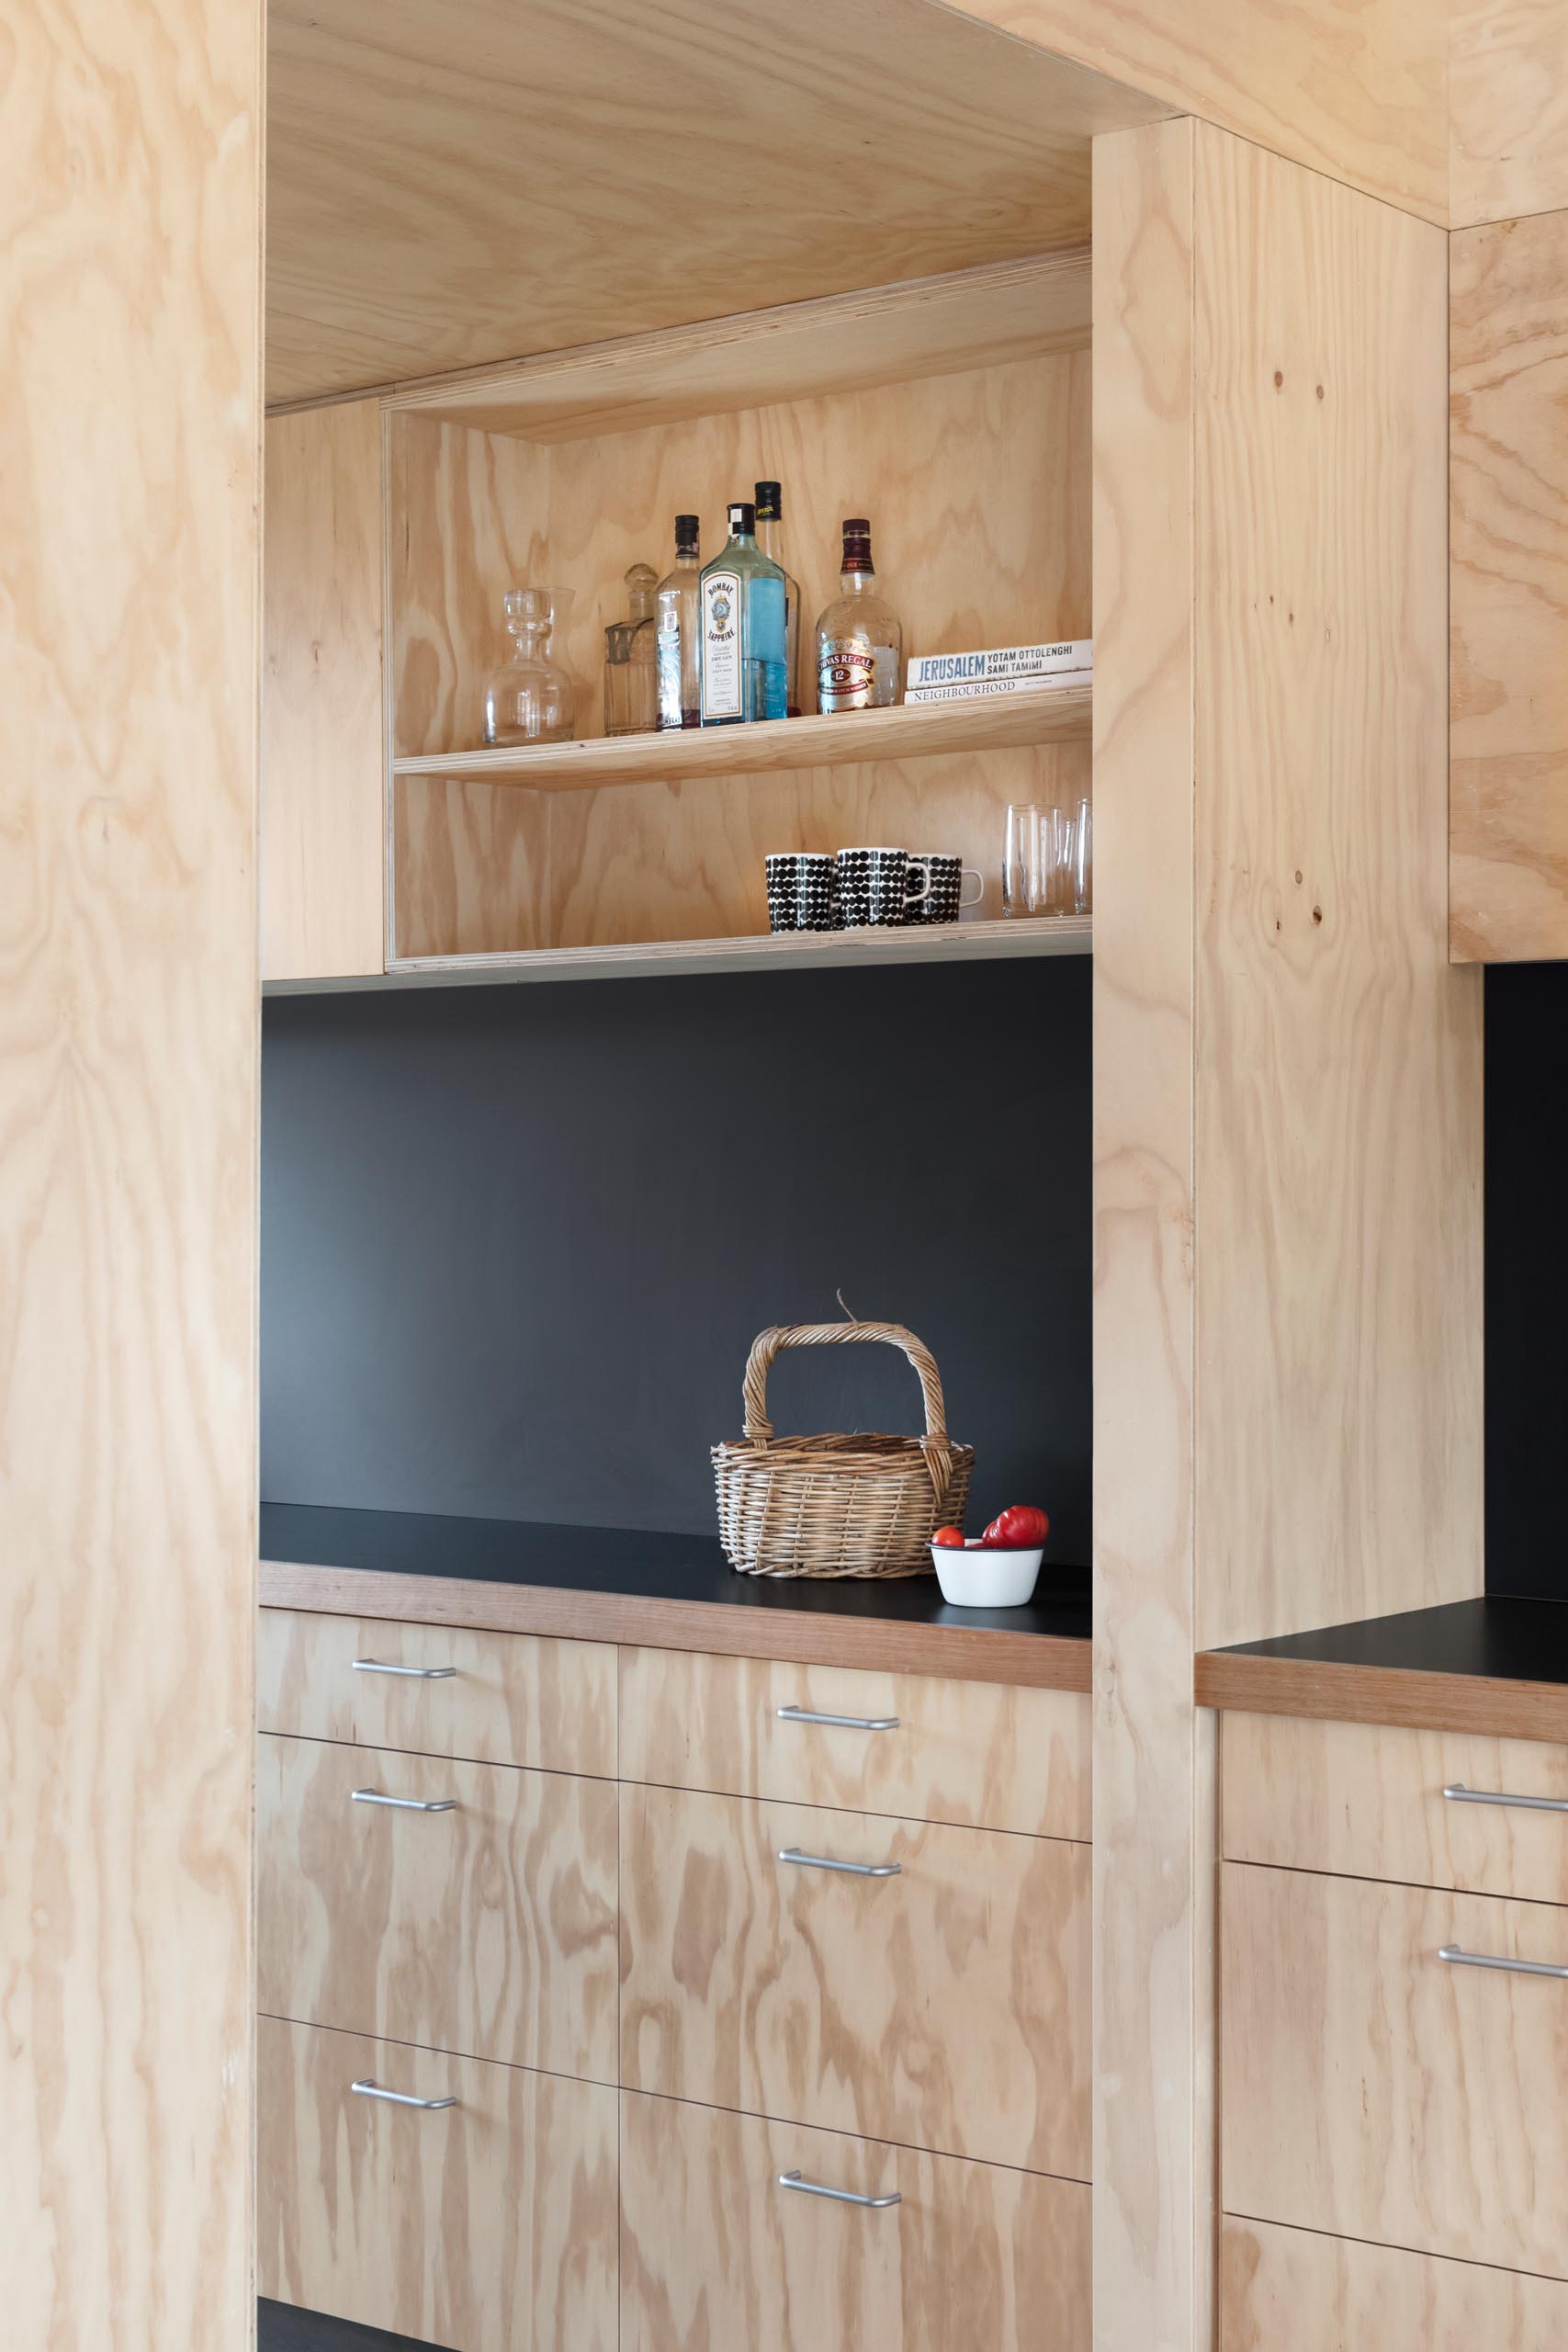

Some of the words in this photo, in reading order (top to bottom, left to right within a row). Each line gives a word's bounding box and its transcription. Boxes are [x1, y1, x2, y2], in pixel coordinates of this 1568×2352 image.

[708, 582, 734, 596] BOMBAY
[707, 627, 735, 642] SAPPHIRE
[841, 654, 872, 668] REGAL
[919, 655, 986, 683] JERUSALEM
[987, 650, 1016, 663] YOTAM
[1019, 645, 1072, 660] OTTOLENGHI
[987, 663, 1009, 674] SAMI
[1011, 660, 1043, 672] TAMIMI
[835, 670, 844, 680] 12
[914, 681, 1016, 702] NEIGHBOURHOOD
